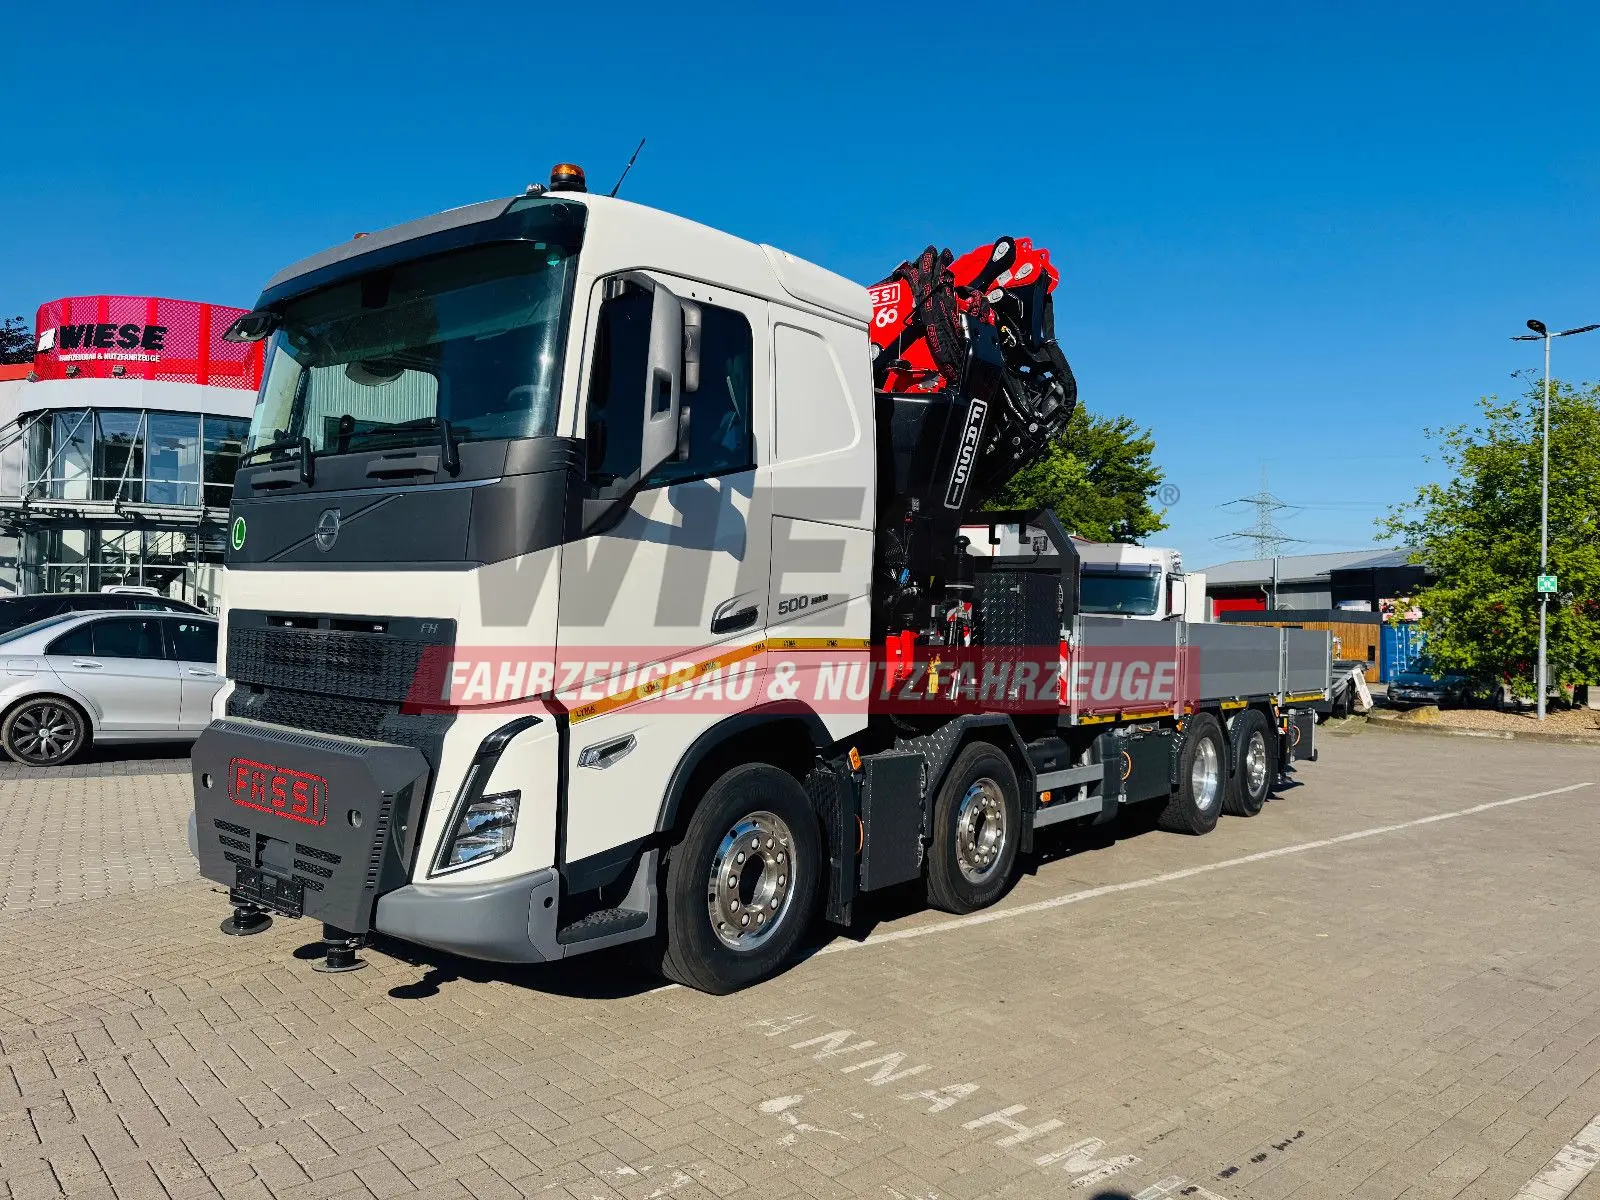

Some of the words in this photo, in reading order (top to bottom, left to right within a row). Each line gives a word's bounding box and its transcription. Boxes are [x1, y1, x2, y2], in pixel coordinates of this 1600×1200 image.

[870, 287, 896, 305] SSI
[60, 324, 168, 350] WIESE
[104, 353, 160, 362] NUTZFAHRZEUGE
[952, 405, 984, 503] FASSI
[778, 595, 809, 615] 500
[420, 623, 439, 633] FH
[576, 704, 596, 718] LYMA
[643, 681, 661, 693] LYMA
[752, 642, 766, 652] LYMA
[235, 767, 319, 816] FASSI
